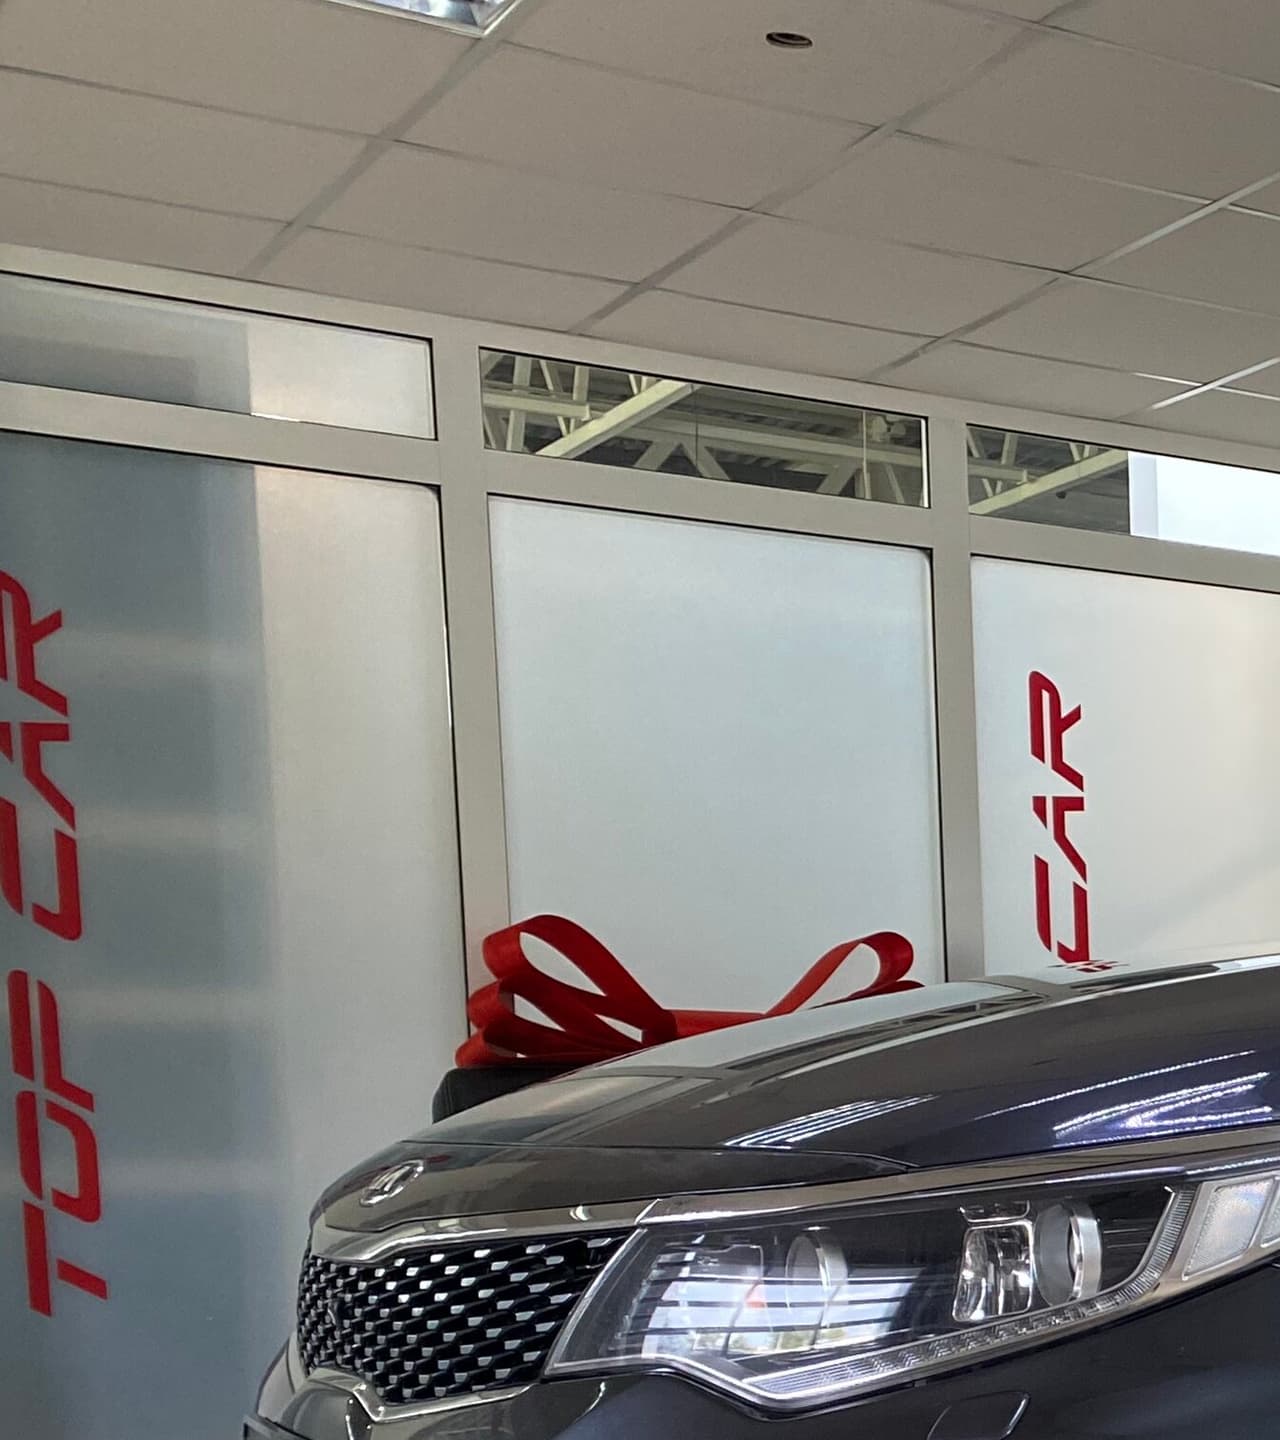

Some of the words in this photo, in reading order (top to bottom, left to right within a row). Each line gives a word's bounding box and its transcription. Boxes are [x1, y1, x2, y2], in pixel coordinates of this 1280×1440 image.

[0, 570, 83, 942] CAR
[1028, 670, 1089, 964] CAR
[7, 970, 109, 1317] TOP
